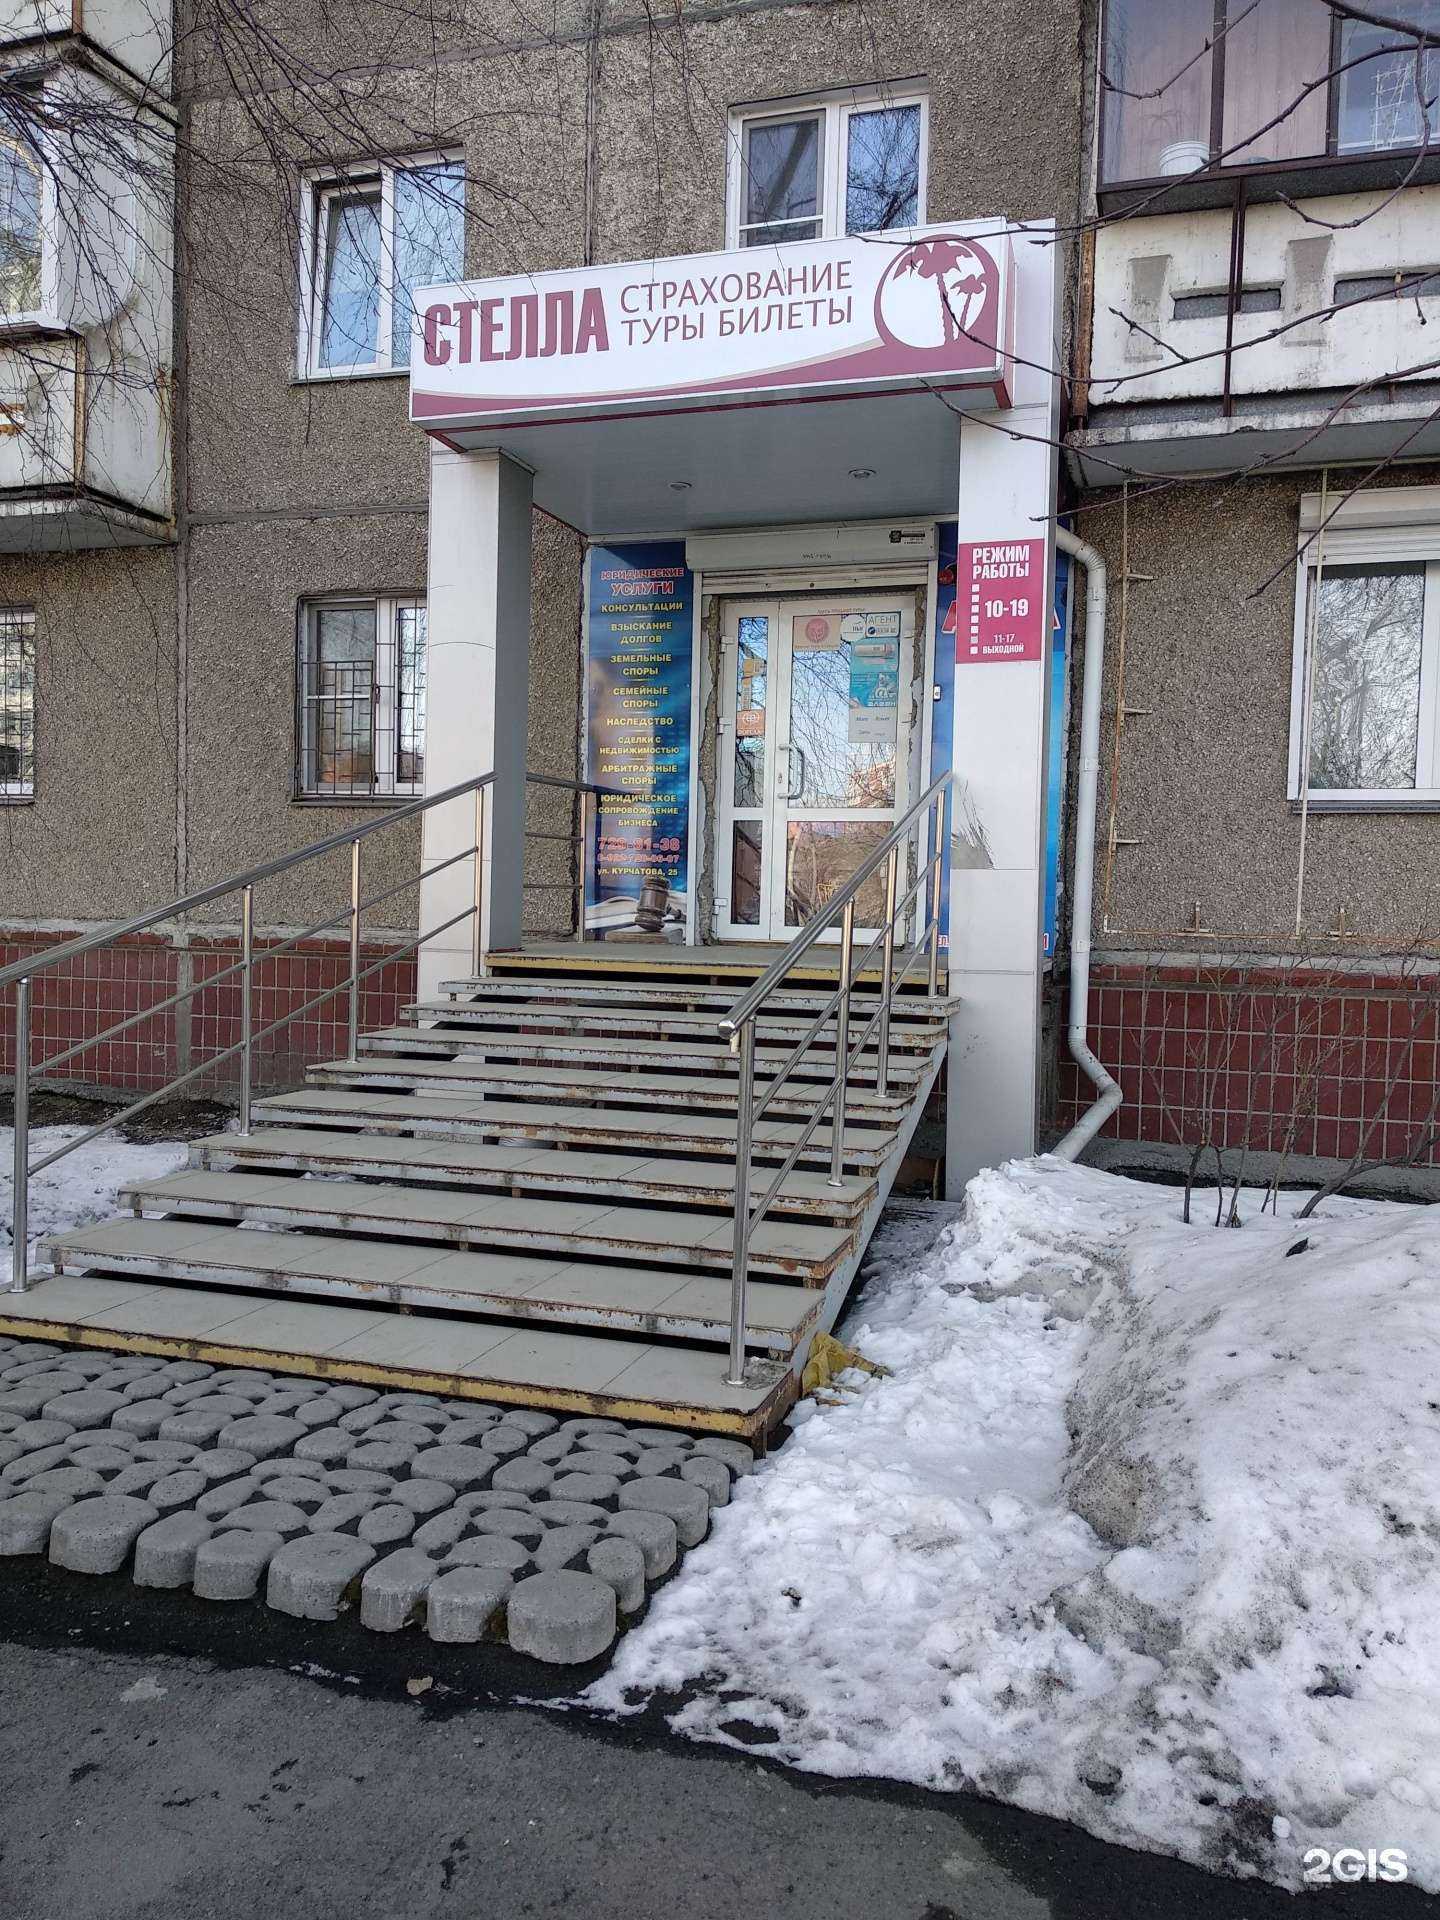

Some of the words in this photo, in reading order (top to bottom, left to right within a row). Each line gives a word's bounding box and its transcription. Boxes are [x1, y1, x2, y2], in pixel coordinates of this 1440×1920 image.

[620, 259, 853, 314] СТРАХОВАНИЕ
[423, 286, 610, 366] СТЕЛЛА
[621, 312, 706, 347] ТУРЫ
[717, 295, 853, 337] БИЛЕТЫ
[972, 545, 1030, 565] РЕЖИМ
[600, 568, 685, 581] ЮРИДИЧЕСКИЕ
[972, 562, 1030, 580] РАБОТЫ
[611, 581, 674, 596] УСЛУГИ
[601, 602, 683, 613] КОНСУЛЬТАЦИИ
[984, 598, 1029, 618] 10-19
[611, 621, 673, 632] ВЗЫСКАНИЕ
[620, 635, 662, 645] ДОЛГОВ
[993, 633, 1015, 643] 11-17
[982, 642, 1024, 655] ВЫХОДНОЙ
[610, 653, 672, 663] ЗЕМЕЛЬНЫЕ
[622, 667, 659, 676] СПОРЫ
[613, 685, 669, 695] СЕМЕЙНЫЕ
[622, 699, 658, 709] СПОРЫ
[607, 717, 674, 727] НАСЛЕДСТВО
[618, 736, 654, 745] СДЕЛКИ
[599, 746, 680, 755] НЕДВИЖИМОСТЬЮ
[601, 764, 678, 773] АРБИТРАЖНЫЕ
[621, 776, 657, 785] СПОРЫ
[600, 793, 677, 803] ЮРИДИЧЕСКОЕ
[598, 806, 679, 815] СОПРОВОЖДЕНИЕ
[618, 819, 658, 827] БИЗНЕСА
[612, 866, 666, 876] КУРЧАТОВА,
